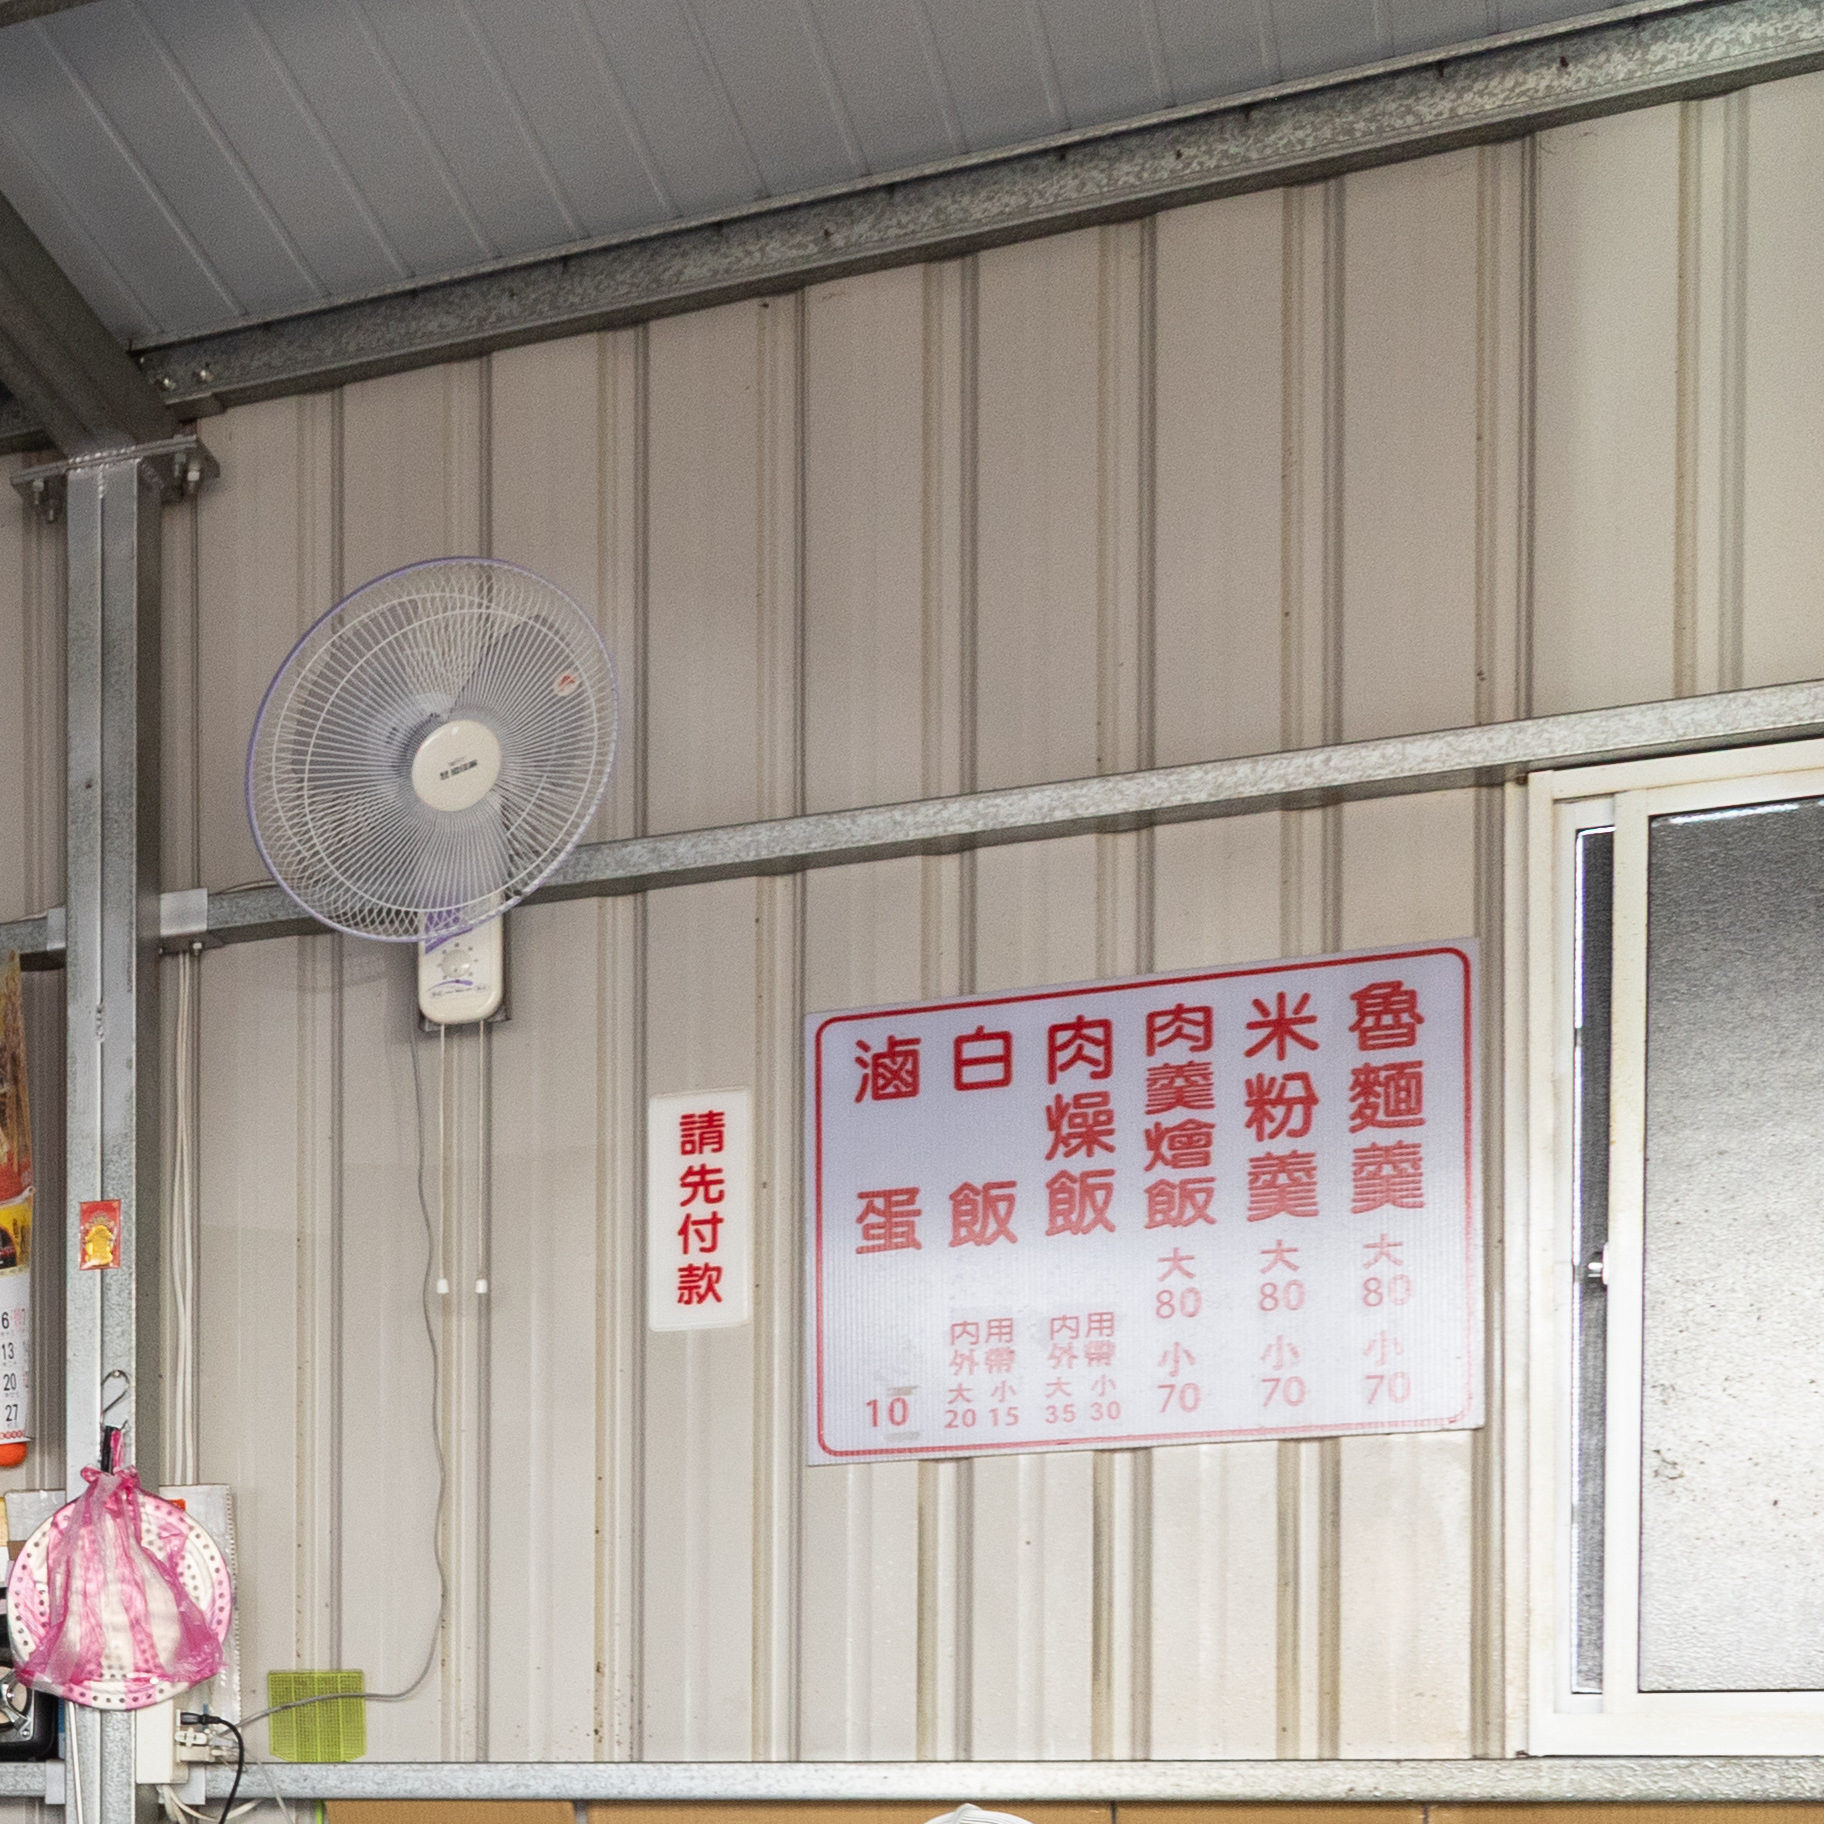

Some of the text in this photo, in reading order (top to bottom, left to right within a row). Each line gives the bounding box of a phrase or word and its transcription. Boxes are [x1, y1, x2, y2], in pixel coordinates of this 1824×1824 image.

[1244, 992, 1319, 1222] 米粉羹
[1348, 980, 1426, 1215] 魯麵羹
[1045, 1015, 1116, 1238] 肉燥飯
[1143, 1003, 1218, 1228] 肉羹燴飯
[854, 1034, 924, 1256] 滷蛋
[948, 1026, 1018, 1247] 白飯
[677, 1111, 725, 1306] 請先付款
[1159, 1248, 1195, 1281] 大
[1261, 1240, 1300, 1274] 大
[1364, 1233, 1404, 1268] 大
[1155, 1287, 1202, 1320] 80
[1259, 1279, 1305, 1313] 80
[1362, 1273, 1412, 1307] 80
[2, 1312, 10, 1329] 6
[2, 1342, 14, 1360] 13
[949, 1347, 1015, 1375] 外帶
[1047, 1341, 1116, 1369] 外帶
[1158, 1342, 1195, 1376] 小
[1261, 1335, 1300, 1371] 小
[1364, 1329, 1403, 1367] 小
[3, 1373, 16, 1391] 20
[949, 1380, 1016, 1403] 大 小
[1046, 1375, 1116, 1398] 大 小
[1158, 1382, 1201, 1413] 70
[1262, 1376, 1305, 1408] 70
[1367, 1371, 1410, 1405] 70
[6, 1404, 18, 1421] 27
[866, 1397, 908, 1427] 10
[945, 1406, 1019, 1429] 20 15
[1045, 1400, 1121, 1424] 35 30
